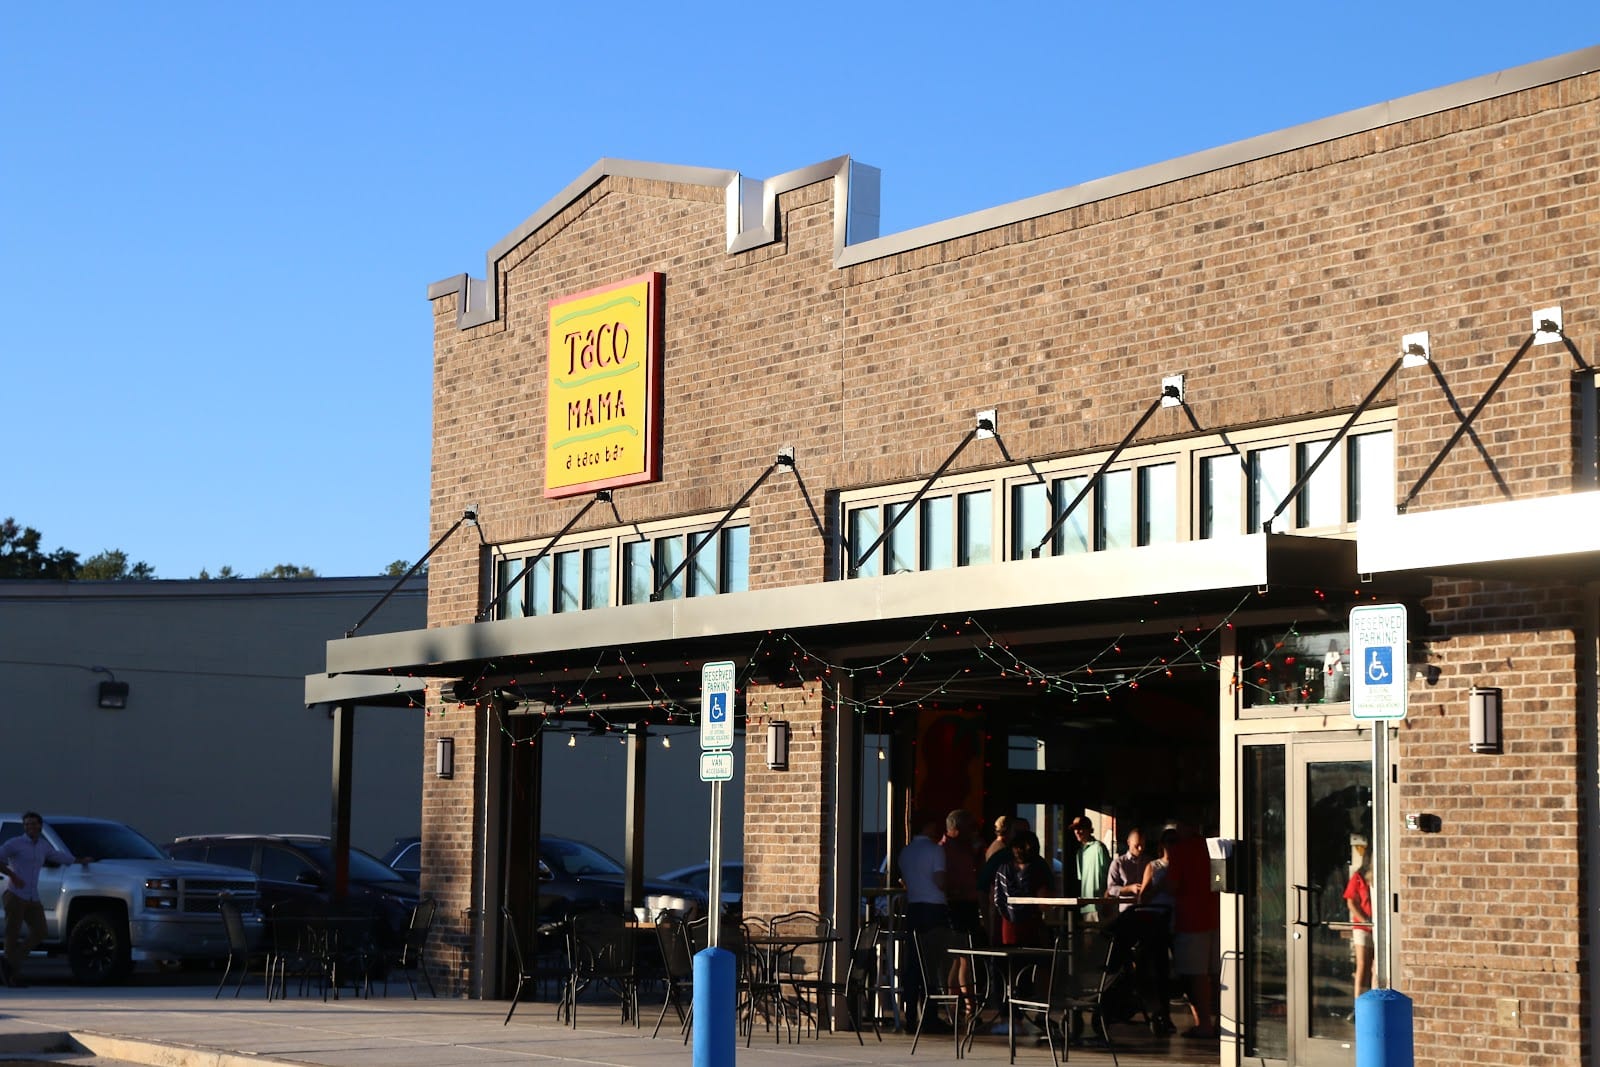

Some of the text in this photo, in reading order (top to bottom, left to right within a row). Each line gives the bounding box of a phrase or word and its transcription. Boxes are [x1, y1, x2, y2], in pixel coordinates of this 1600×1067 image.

[568, 390, 626, 431] MAMA
[566, 444, 625, 470] a taco bar
[1354, 614, 1401, 631] RESERVED
[1359, 631, 1398, 645] PARKING
[704, 669, 732, 682] RESERVED
[707, 681, 730, 692] PARKING
[711, 758, 723, 767] VAN
